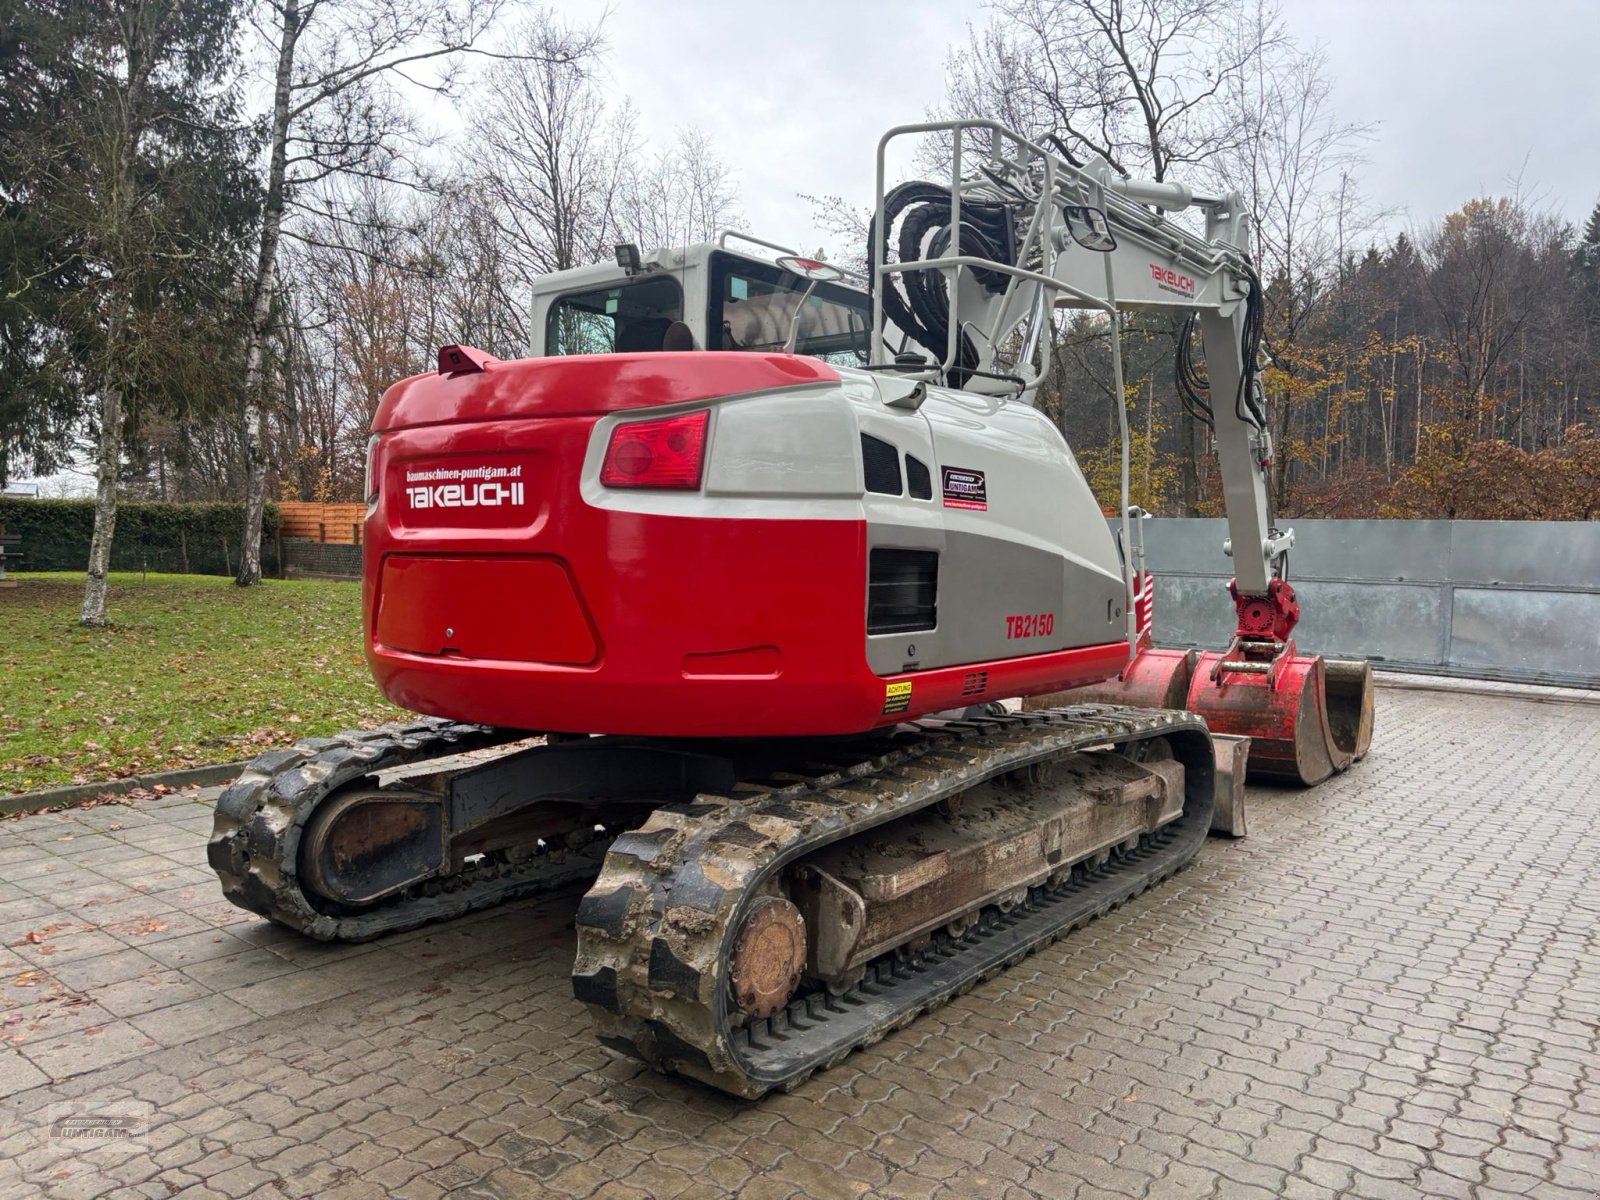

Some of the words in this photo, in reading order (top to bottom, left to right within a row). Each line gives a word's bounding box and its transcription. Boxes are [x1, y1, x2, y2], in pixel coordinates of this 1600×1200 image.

[1149, 264, 1195, 292] TAKEUCHI
[406, 465, 521, 482] baumaschinen-puntigam.at
[406, 482, 524, 509] TAKEUCHI
[1006, 612, 1054, 640] TB2150
[888, 684, 911, 694] ACHTUNG
